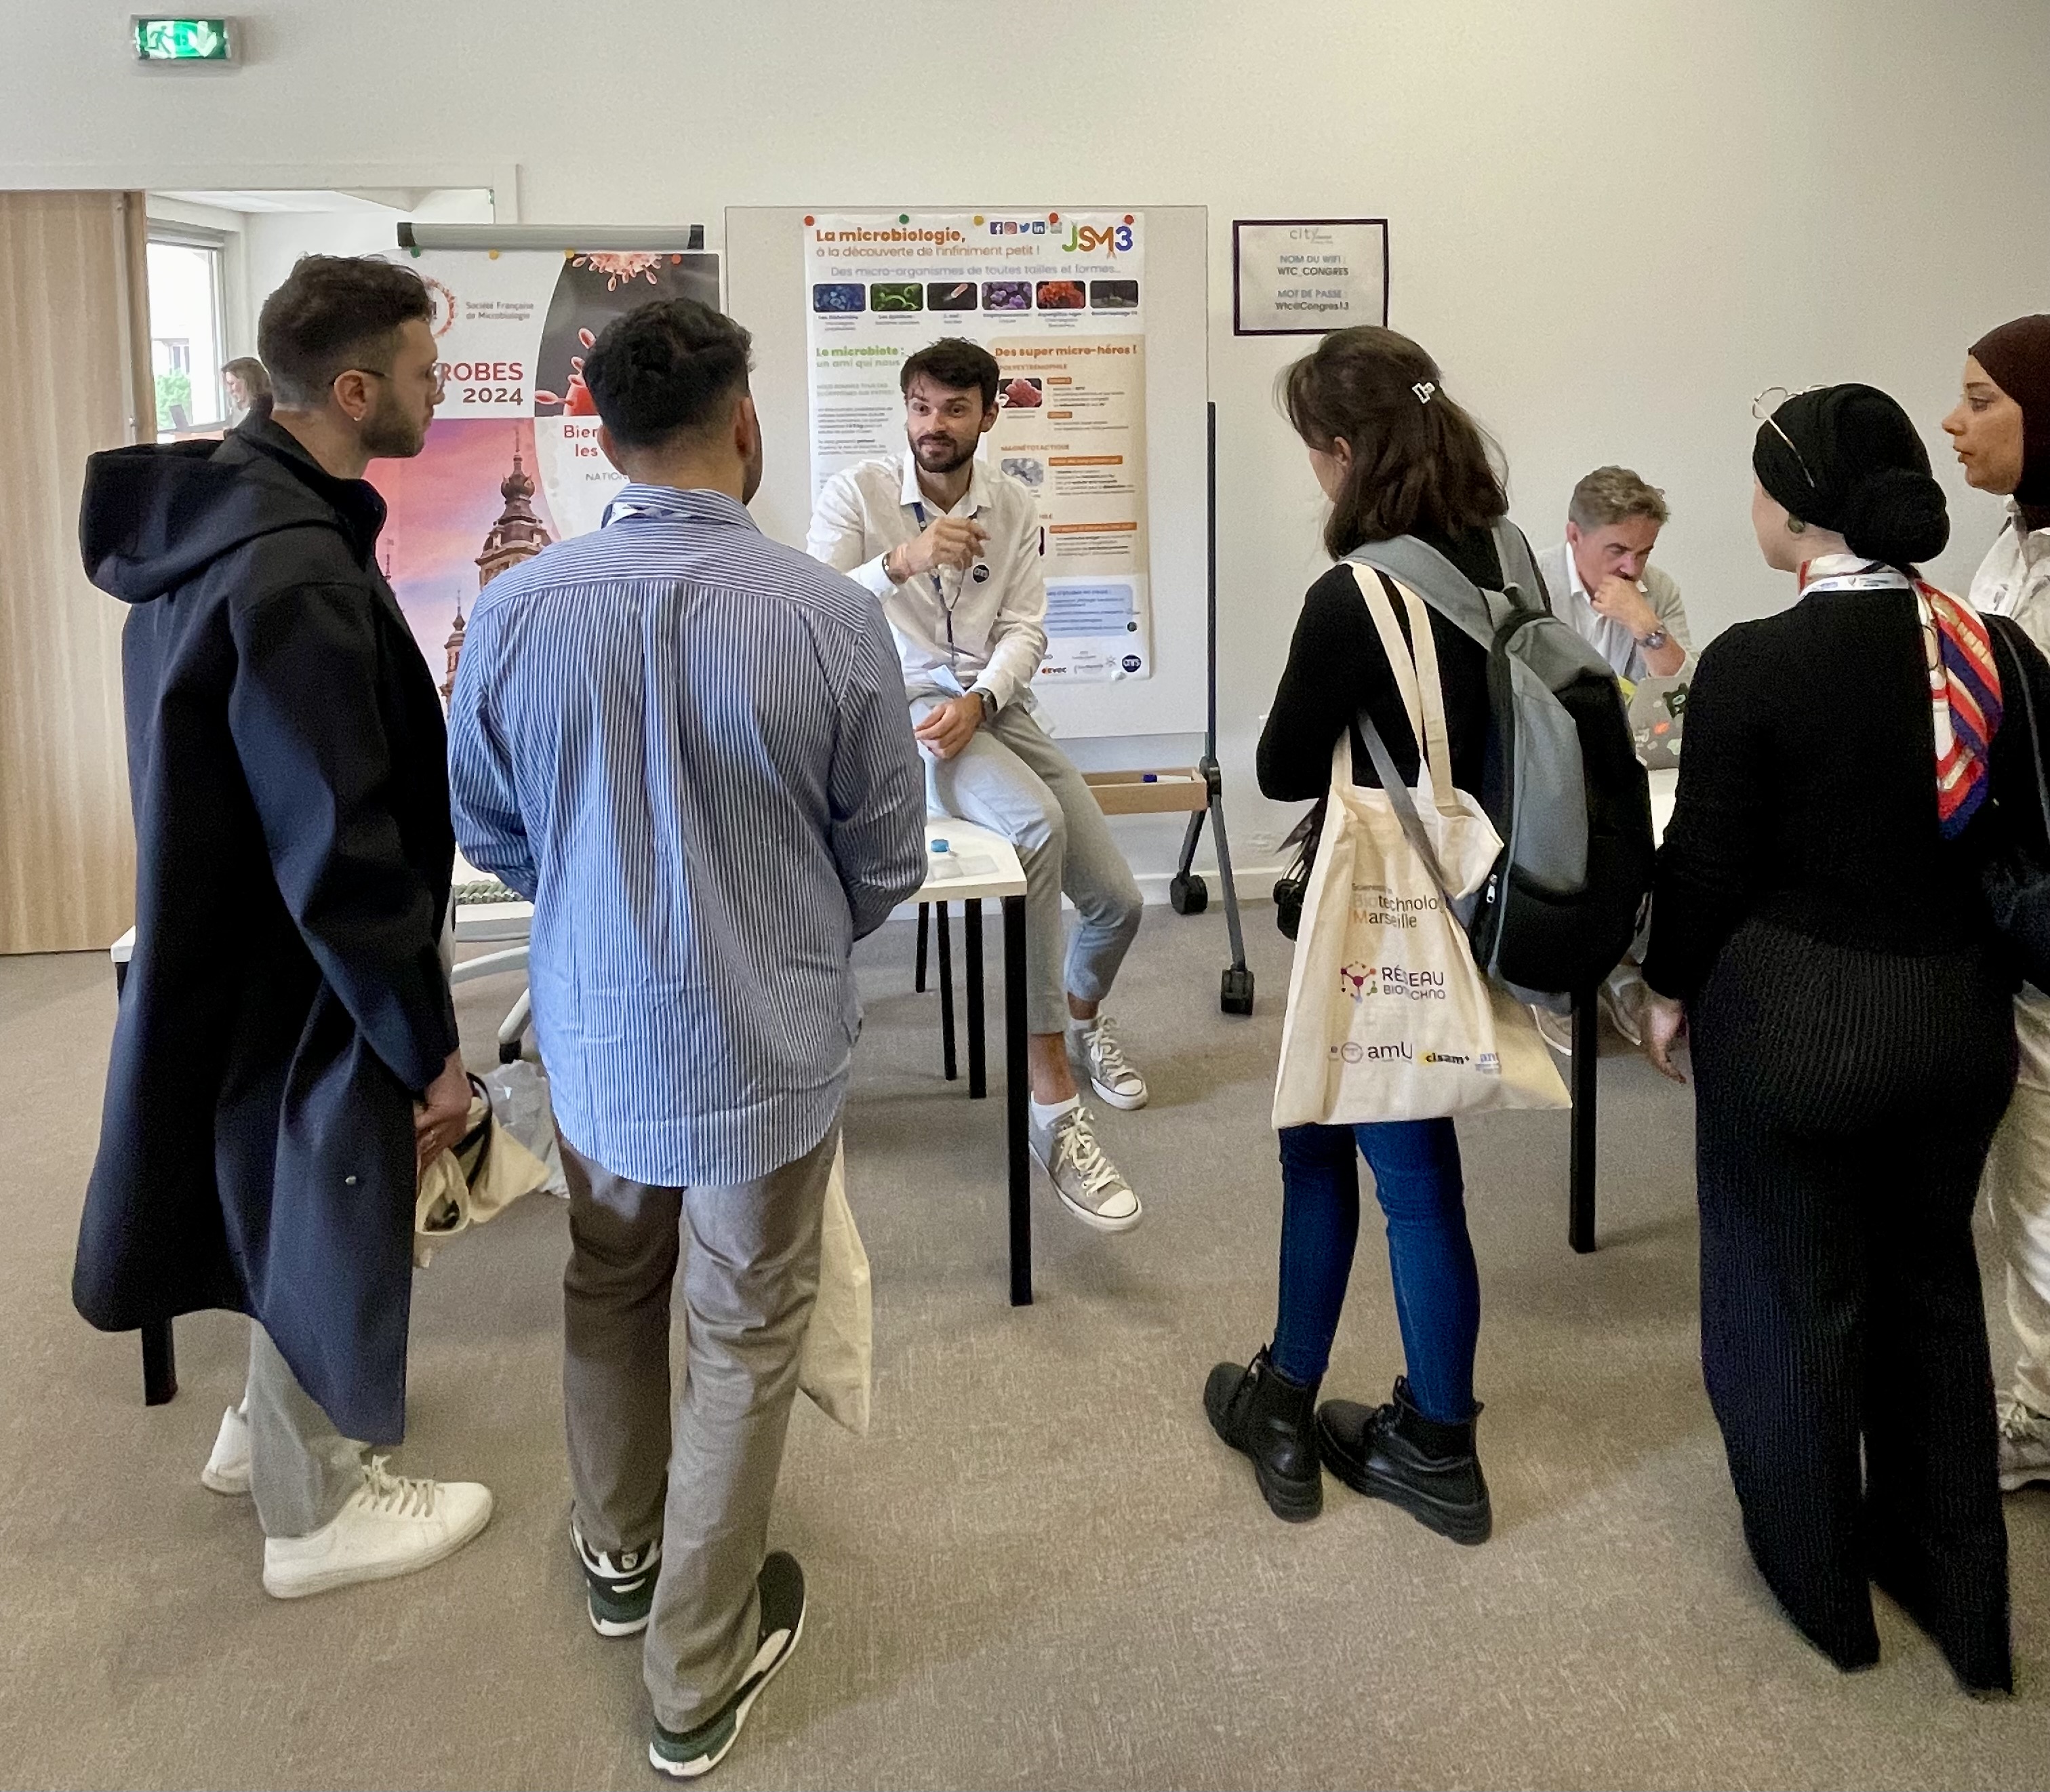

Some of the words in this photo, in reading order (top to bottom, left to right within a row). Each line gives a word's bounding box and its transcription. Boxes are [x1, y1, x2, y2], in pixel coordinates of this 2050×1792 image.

[816, 229, 836, 242] La
[839, 226, 966, 245] microbiologie,
[1062, 222, 1134, 256] JSM3
[828, 246, 839, 257] la
[842, 246, 914, 258] découverte
[917, 245, 933, 256] de
[1005, 244, 1034, 258] petit
[1279, 255, 1304, 264] NOM
[1306, 255, 1320, 263] DU
[830, 266, 853, 277] Des
[854, 266, 965, 279] micro-organismes
[967, 264, 981, 275] de
[985, 264, 1022, 275] toutes
[1024, 263, 1058, 275] tailles
[1060, 264, 1072, 274] et
[1277, 290, 1299, 298] MOT
[1301, 290, 1312, 298] DE
[1315, 290, 1342, 298] PASSE
[831, 344, 899, 357] microbiote
[994, 347, 1017, 357] Des
[1019, 348, 1053, 359] super
[462, 387, 523, 405] 2024
[575, 443, 598, 457] les
[1353, 910, 1418, 929] Marseille
